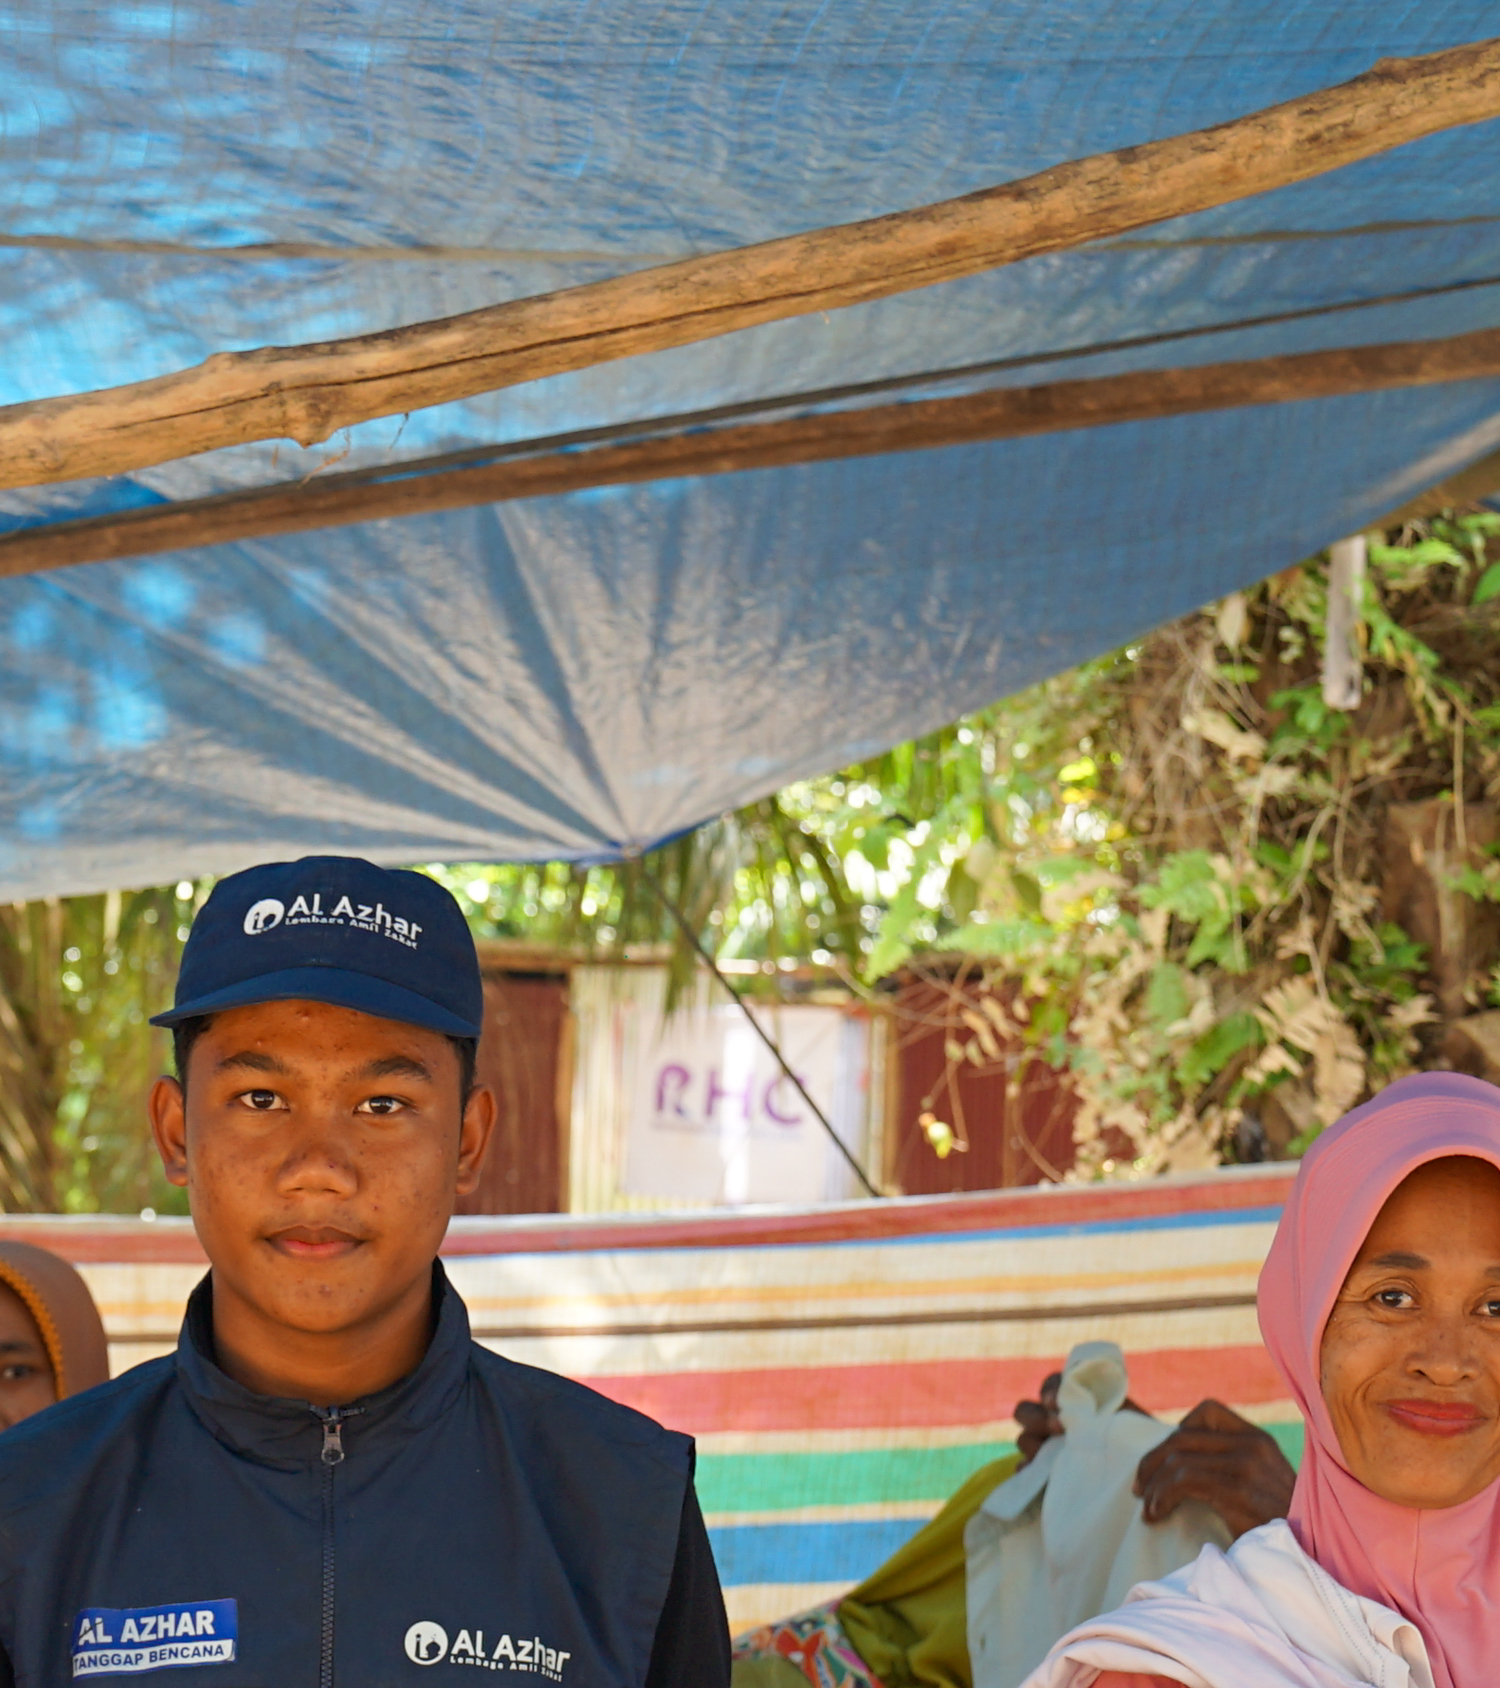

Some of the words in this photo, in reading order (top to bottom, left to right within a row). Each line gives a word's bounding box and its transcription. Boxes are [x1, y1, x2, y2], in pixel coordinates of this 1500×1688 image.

[287, 893, 324, 917] Al
[331, 896, 422, 940] Azhar
[78, 1617, 113, 1645] AL
[120, 1610, 215, 1643] AZHAR
[74, 1653, 144, 1672] TANGGAP
[149, 1643, 225, 1664] BENCANA
[451, 1629, 486, 1658] Al
[492, 1634, 571, 1673] Azhar
